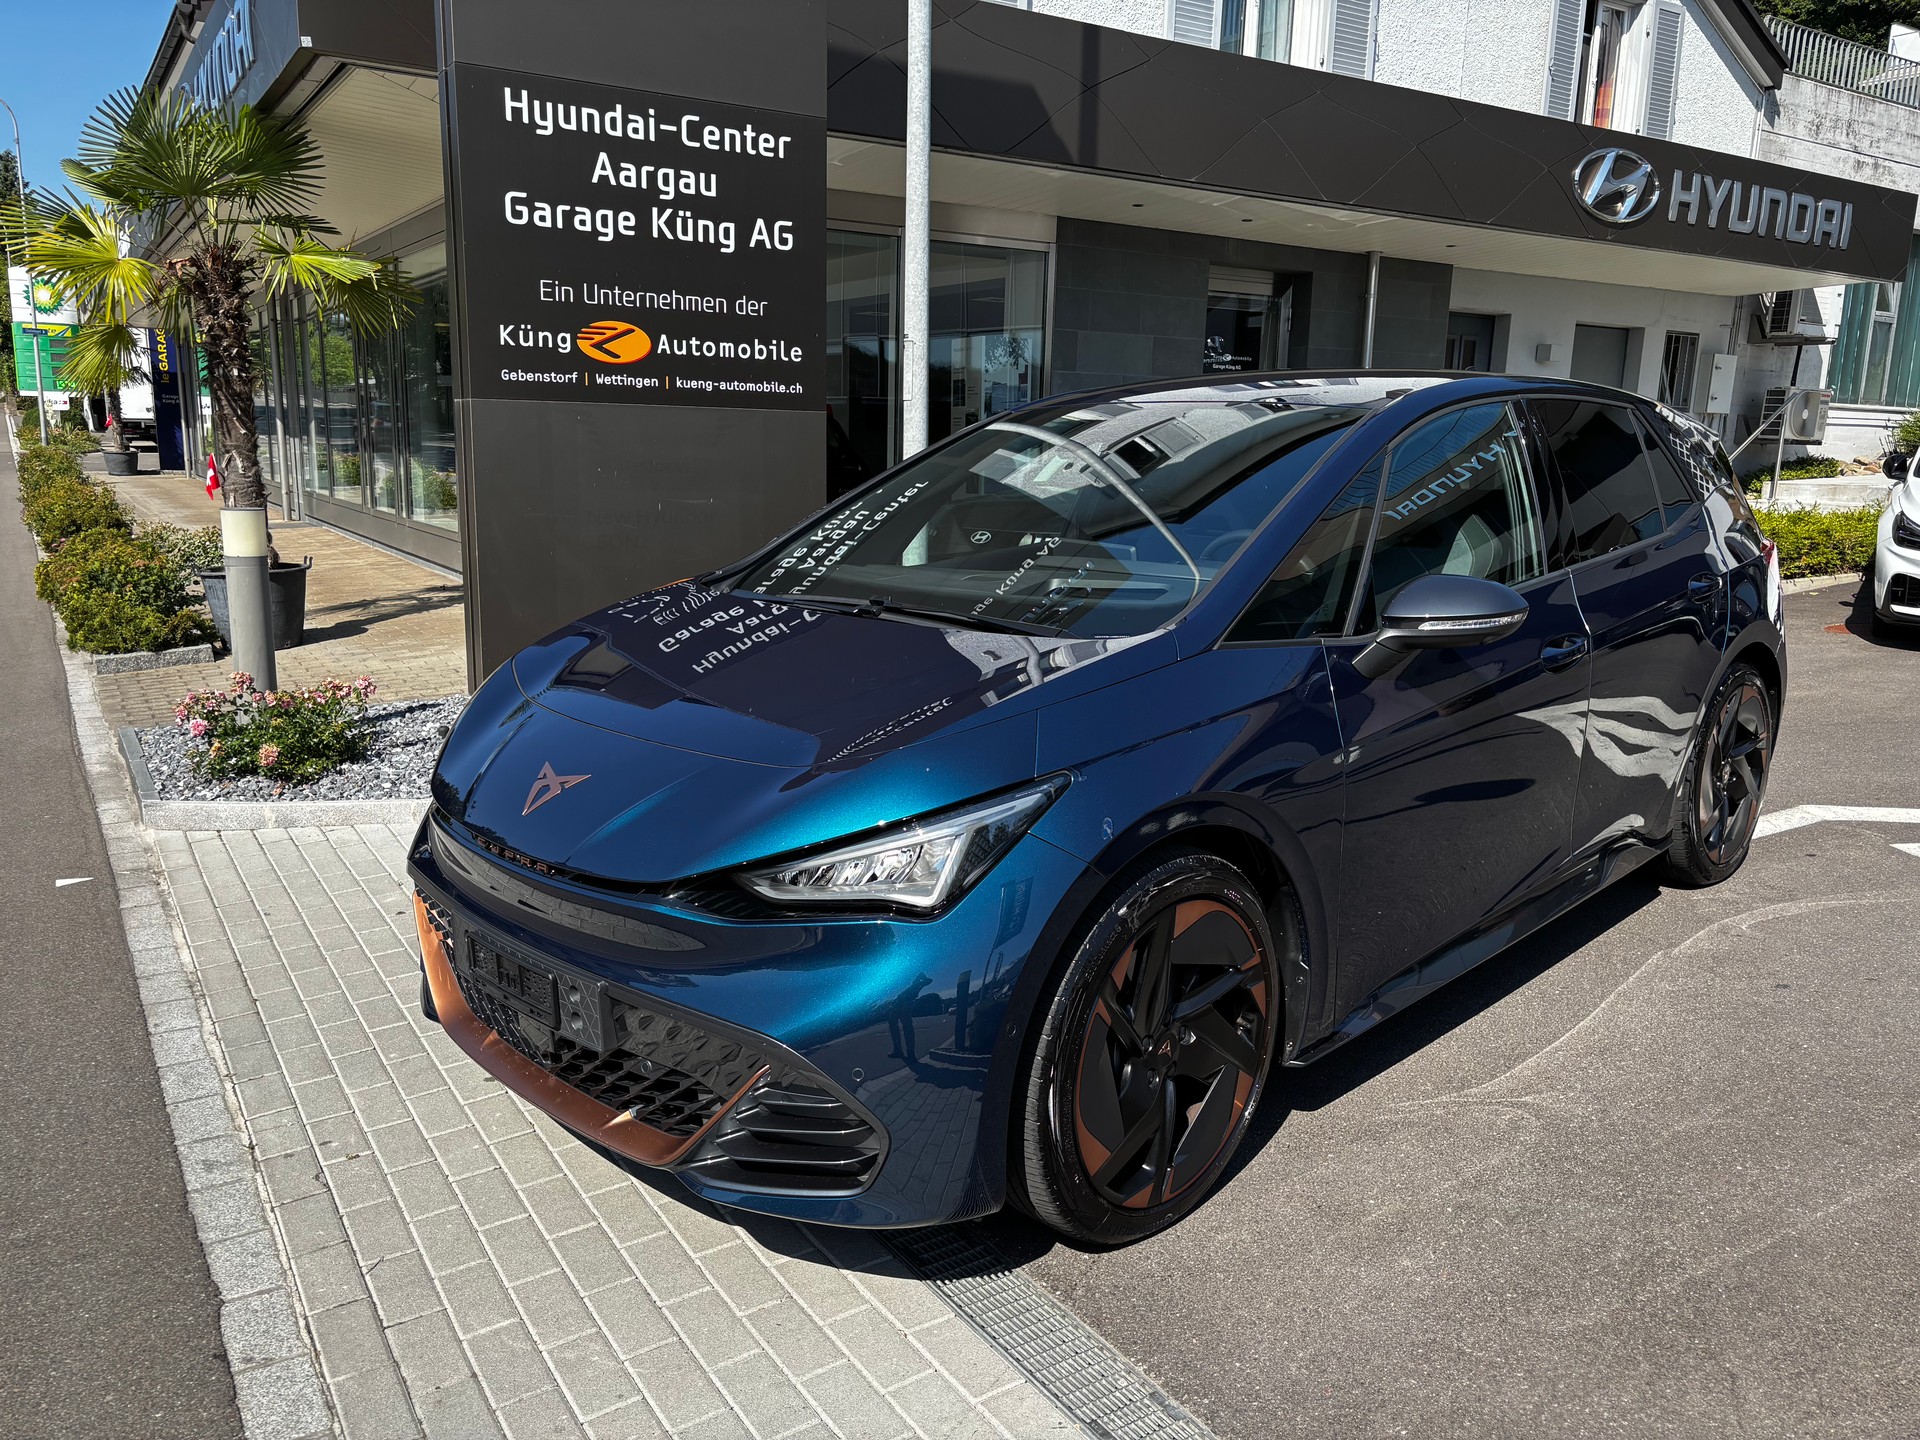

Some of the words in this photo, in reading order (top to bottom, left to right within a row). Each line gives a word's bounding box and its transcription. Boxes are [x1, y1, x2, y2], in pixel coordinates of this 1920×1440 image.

[504, 86, 792, 159] Hyundai-Center
[591, 151, 718, 200] Aargau
[504, 190, 636, 242] Garage
[651, 206, 736, 253] Küng
[749, 218, 794, 251] AG
[1667, 169, 1853, 250] HYUNDAI
[540, 279, 574, 303] Ein
[583, 283, 727, 314] Unternehmen
[735, 295, 768, 316] der
[499, 324, 571, 353] Küng
[657, 334, 803, 362] Automobile
[501, 369, 578, 384] Gebenstorf
[595, 374, 659, 388] Wettingen
[676, 377, 803, 394] kueng-automobile.ch
